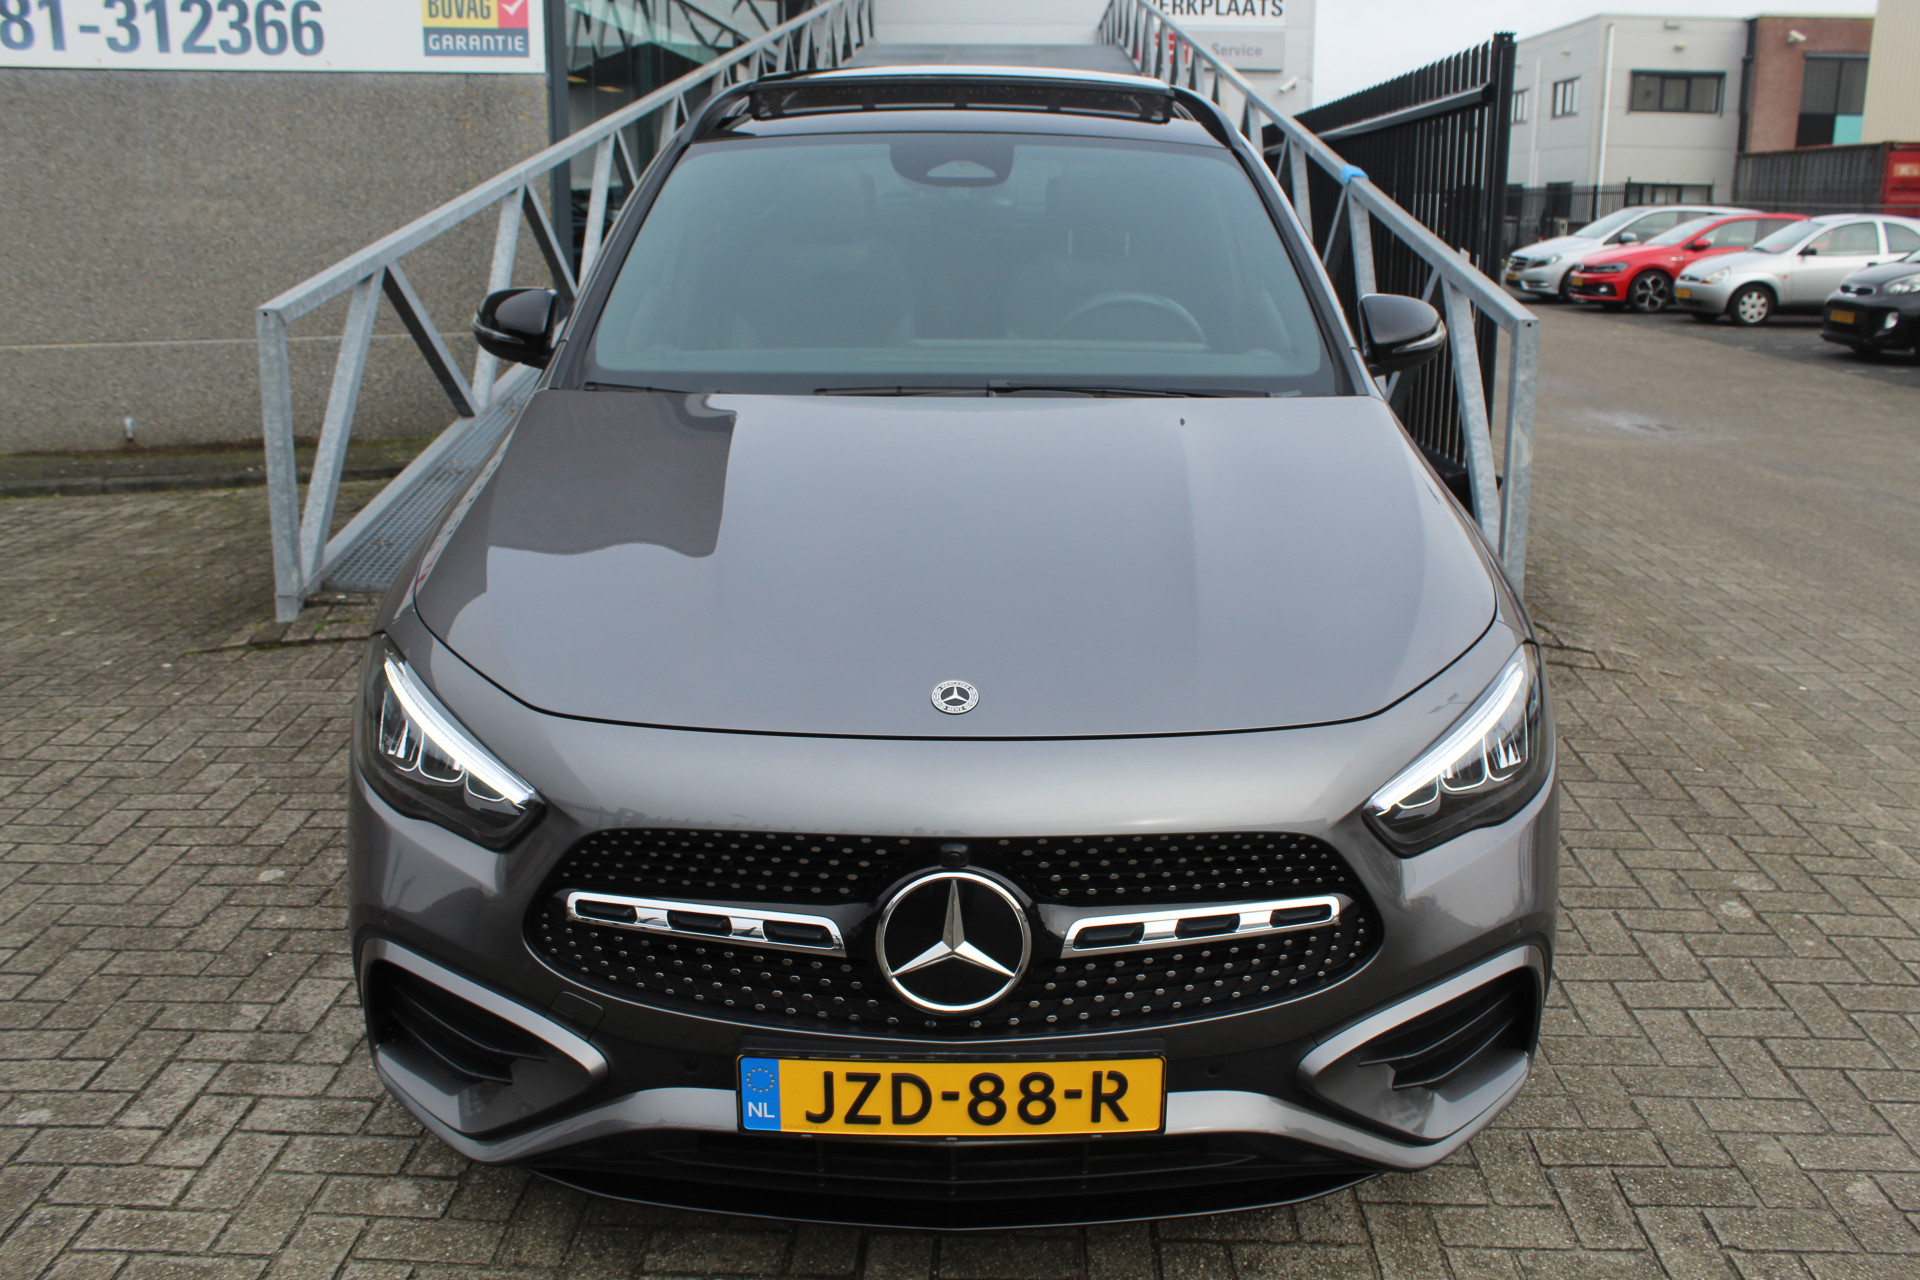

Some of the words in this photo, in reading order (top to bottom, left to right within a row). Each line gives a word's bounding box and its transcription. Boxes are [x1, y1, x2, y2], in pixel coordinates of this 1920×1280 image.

[427, 0, 491, 19] BOVAG
[1153, 0, 1283, 16] ERKPLAATS
[0, 0, 325, 56] 81-312366
[428, 34, 525, 52] GARANTIE
[1211, 43, 1263, 57] Service
[805, 1070, 1129, 1126] JZD-88-R
[748, 1102, 775, 1118] NL
